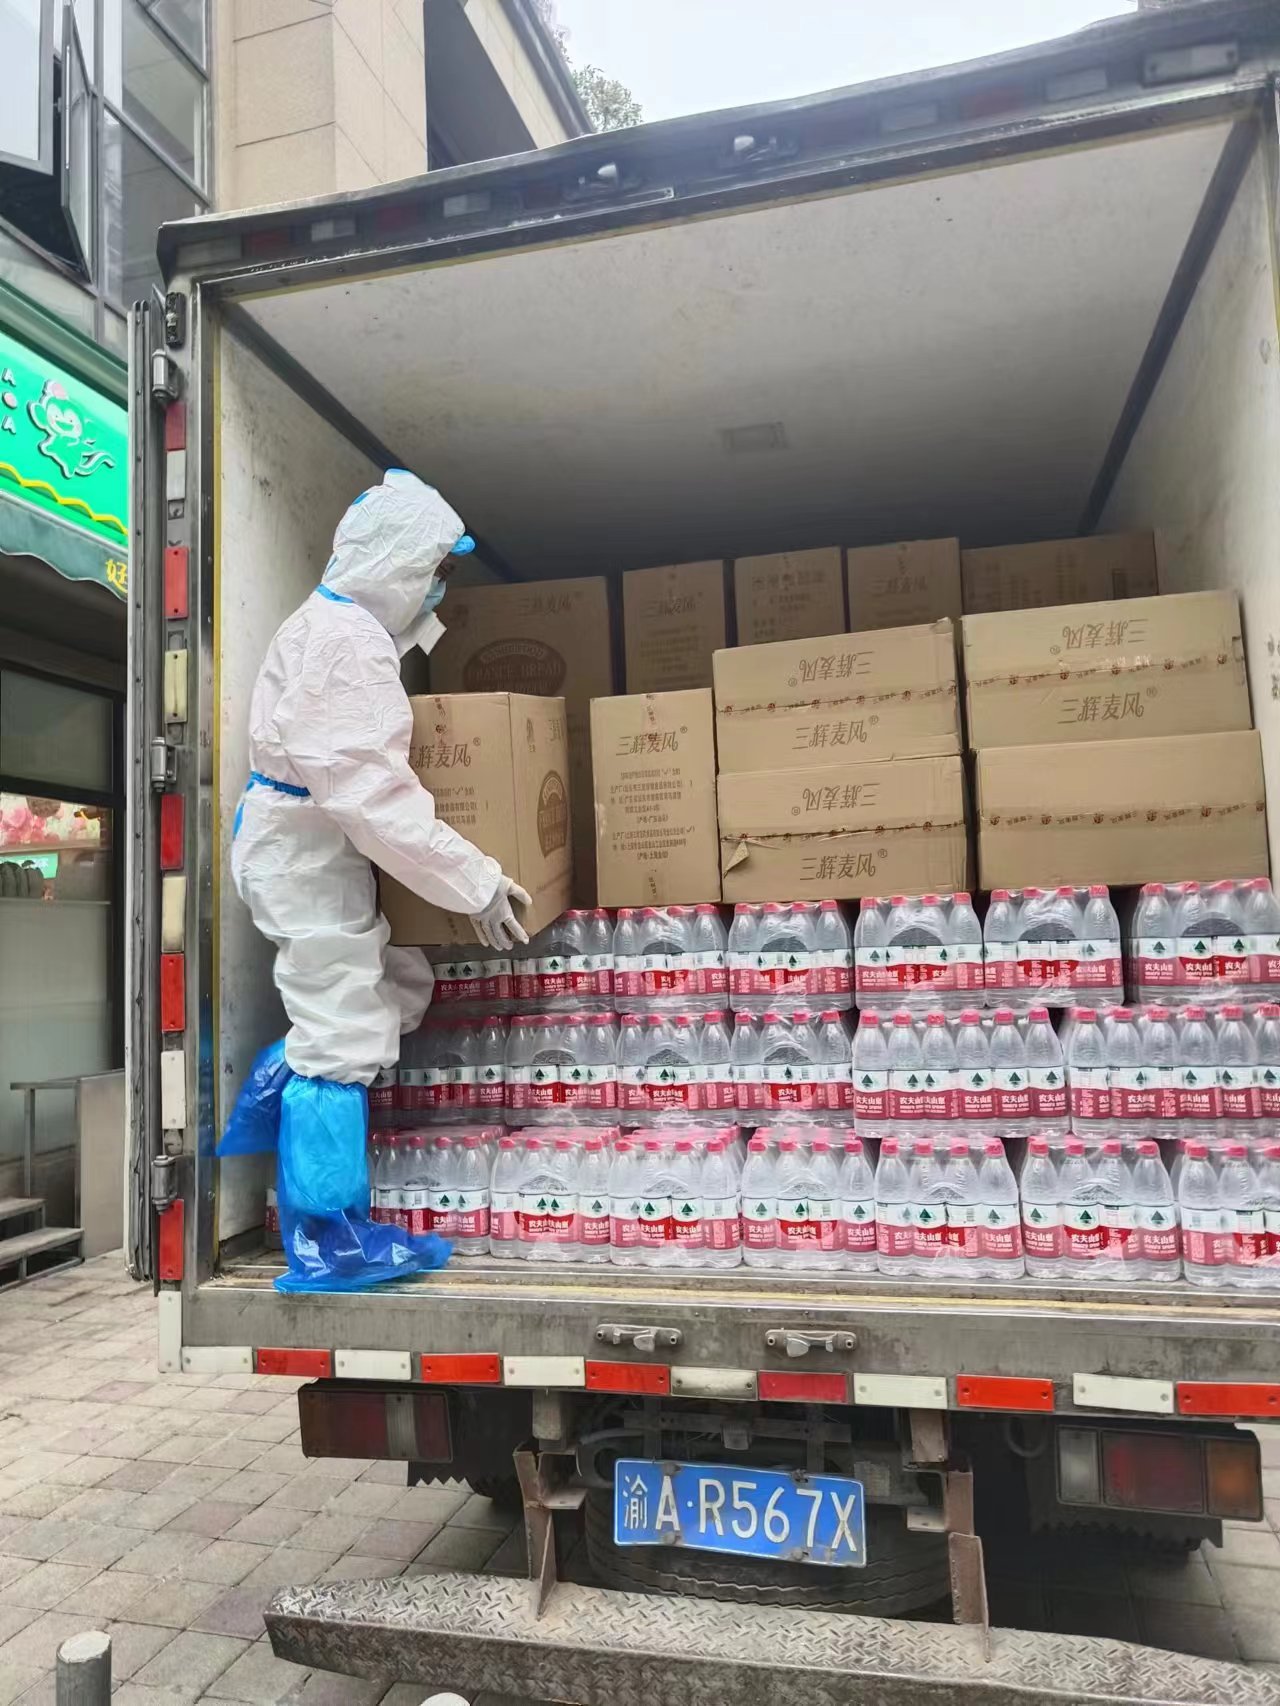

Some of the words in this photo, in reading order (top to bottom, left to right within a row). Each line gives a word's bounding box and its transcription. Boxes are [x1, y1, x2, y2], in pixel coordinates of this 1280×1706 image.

[1063, 618, 1149, 650] 三辉麦风
[799, 651, 875, 682] 三辉麦风
[1058, 691, 1144, 723] 三辉麦风
[615, 731, 679, 757] 三辉麦风
[793, 720, 868, 751] 三辉麦风
[803, 783, 880, 812] 三辉麦风
[800, 852, 876, 881] 三辉麦风
[856, 1096, 883, 1105] 农夫山泉
[964, 1095, 992, 1104] 农夫山泉
[1002, 1095, 1029, 1104] 农夫山泉
[1038, 1093, 1066, 1103] 农夫山泉
[1071, 1234, 1102, 1244] 农夫山泉
[1144, 1234, 1175, 1244] 农夫山泉
[622, 1473, 857, 1552] 渝A·R567X
